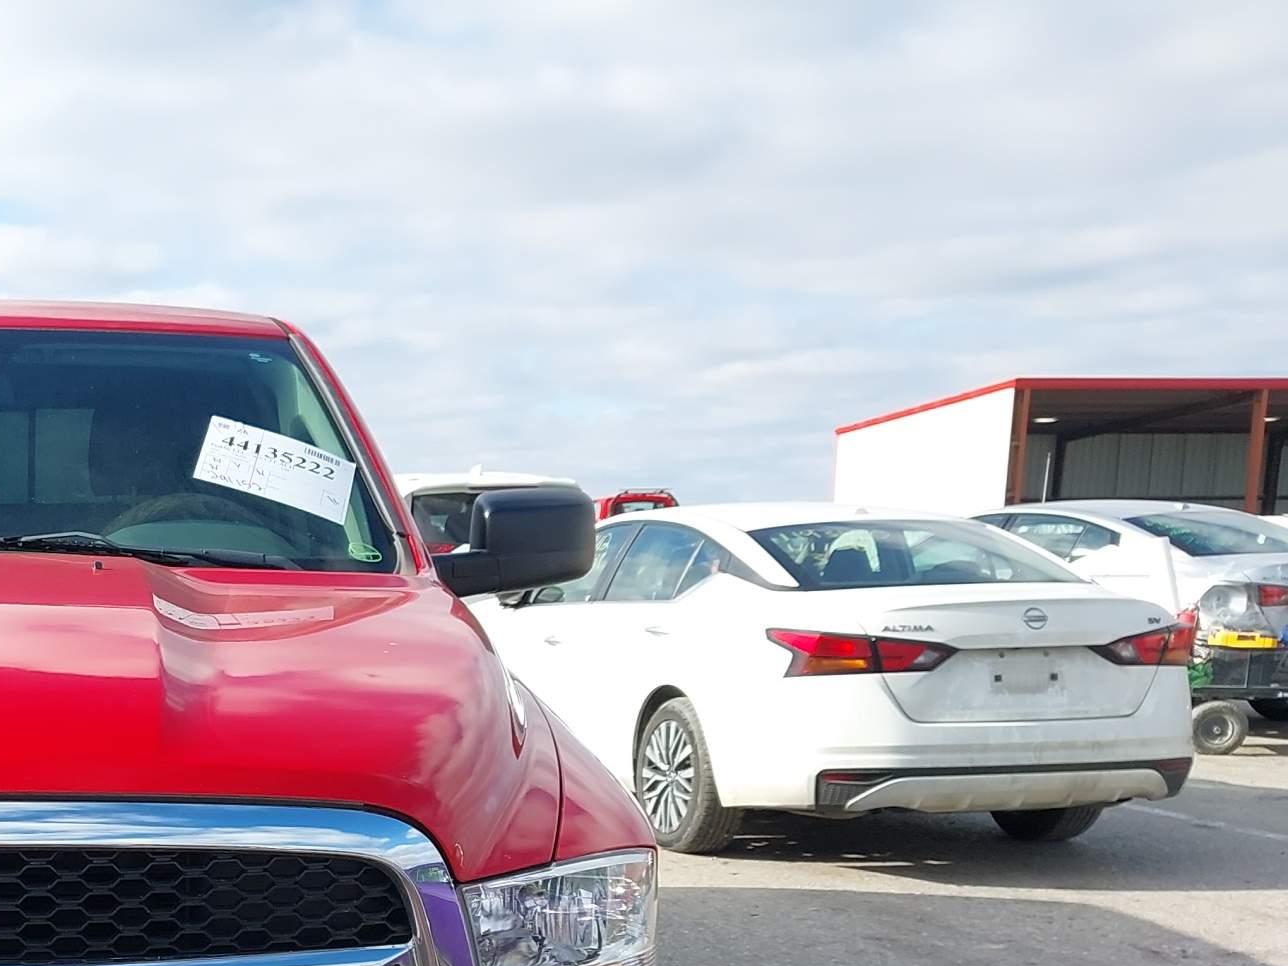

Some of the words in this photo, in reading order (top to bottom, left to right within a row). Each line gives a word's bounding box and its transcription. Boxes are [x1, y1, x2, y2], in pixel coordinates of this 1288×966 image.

[221, 434, 336, 482] 44135222
[1147, 617, 1162, 625] SV
[881, 624, 935, 633] ALTIMA
